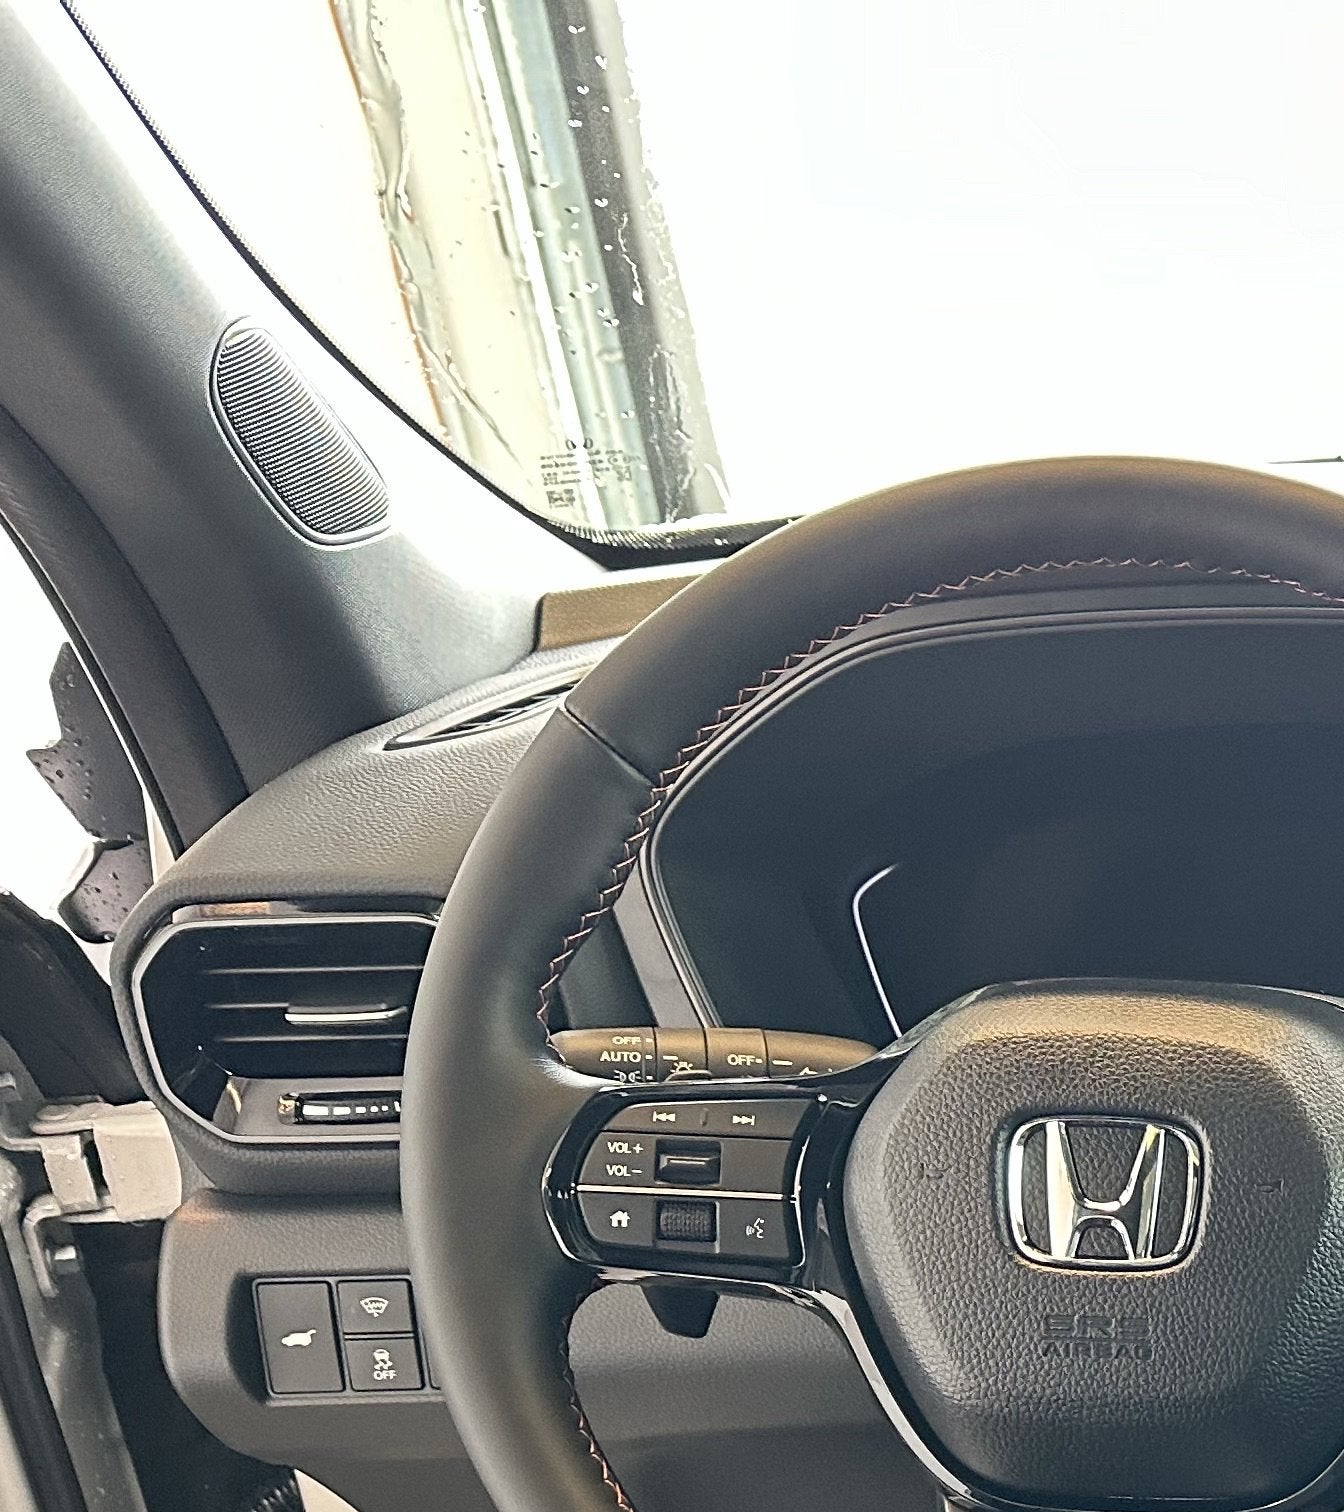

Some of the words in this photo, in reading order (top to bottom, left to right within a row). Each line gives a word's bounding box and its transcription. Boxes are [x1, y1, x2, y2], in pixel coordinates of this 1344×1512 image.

[611, 1035, 641, 1046] OFF
[600, 1050, 642, 1064] AUTO
[726, 1054, 756, 1067] OFF
[373, 1369, 397, 1381] OFF
